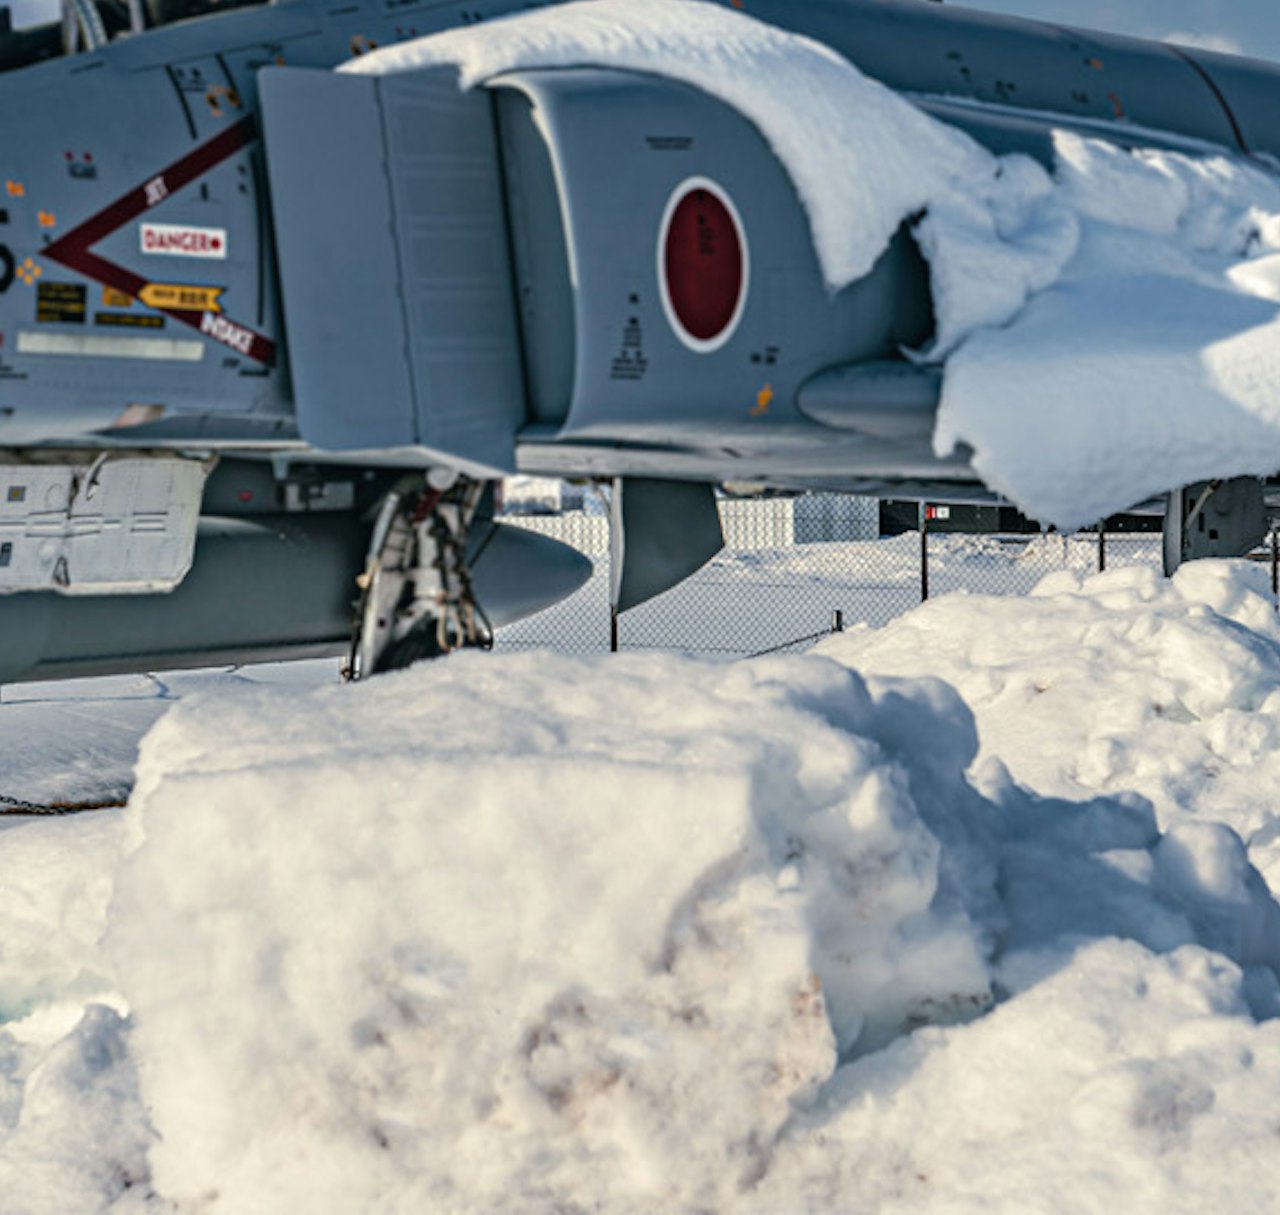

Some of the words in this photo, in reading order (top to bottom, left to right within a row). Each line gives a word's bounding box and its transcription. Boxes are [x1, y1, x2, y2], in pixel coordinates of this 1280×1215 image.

[144, 175, 169, 207] JET
[144, 229, 208, 252] DANGER
[200, 311, 255, 354] INTAKE
